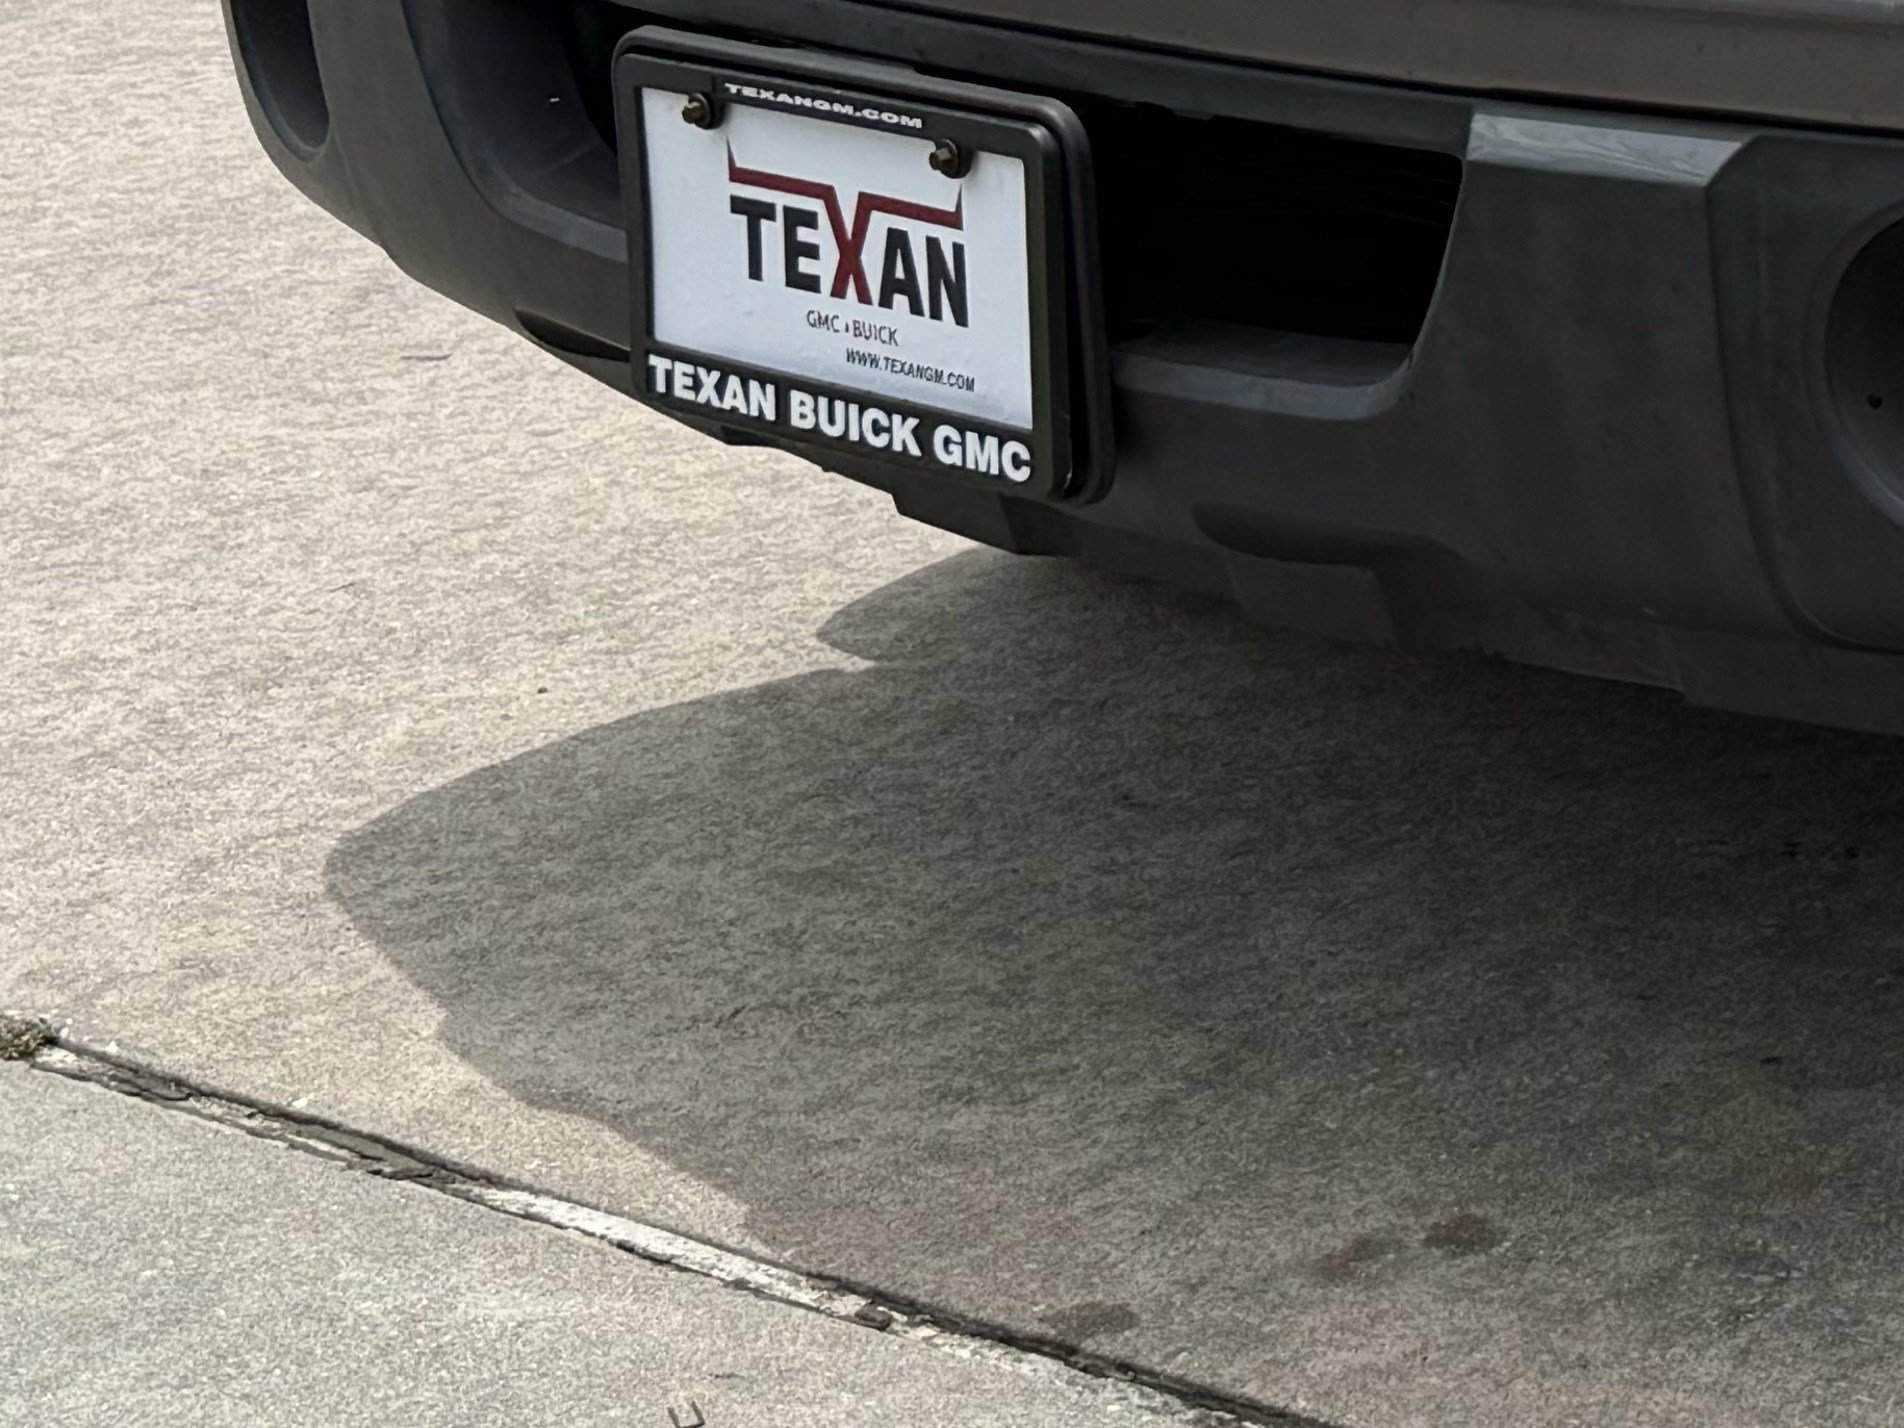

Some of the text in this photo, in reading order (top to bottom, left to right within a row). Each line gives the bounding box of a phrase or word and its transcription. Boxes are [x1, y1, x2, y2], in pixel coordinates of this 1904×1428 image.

[725, 82, 923, 129] TEXANGM.COM
[727, 166, 969, 328] TEXAN
[806, 309, 900, 347] GMC BUICK
[845, 346, 976, 393] WWW.TEXANGM.COM
[648, 353, 1032, 482] TEXAN BUICK GMC
